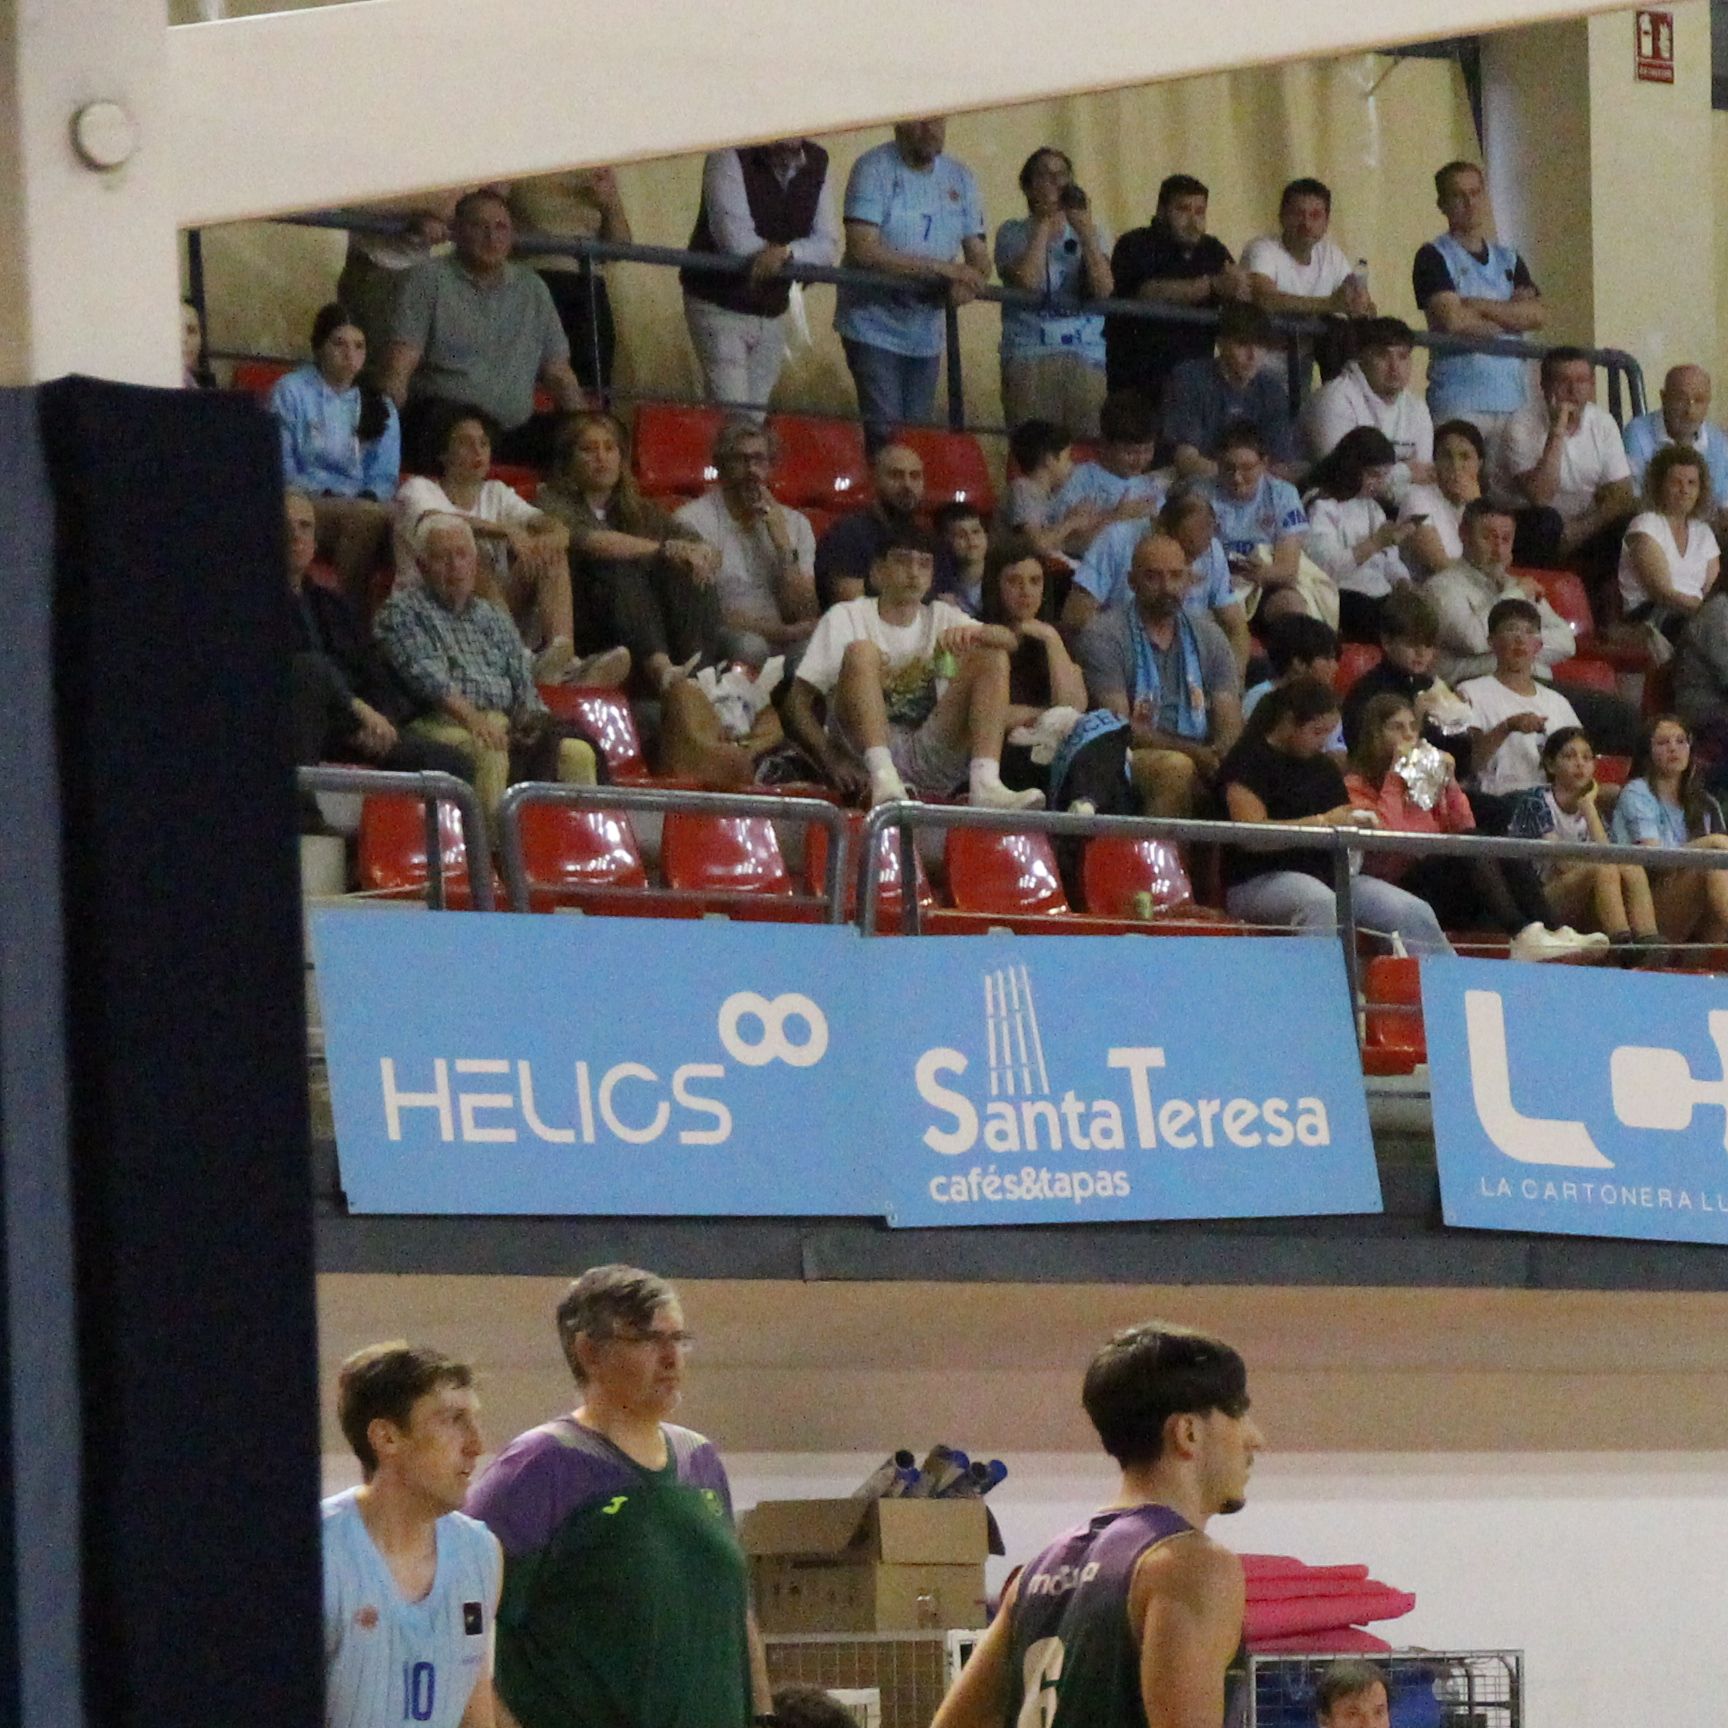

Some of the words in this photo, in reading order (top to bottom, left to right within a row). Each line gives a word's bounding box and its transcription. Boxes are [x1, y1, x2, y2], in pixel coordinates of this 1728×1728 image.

[928, 1164, 1131, 1206] cafés&tapas
[1480, 1176, 1510, 1198] LA
[1521, 1179, 1693, 1211] CARTONERA
[402, 1660, 436, 1722] 10
